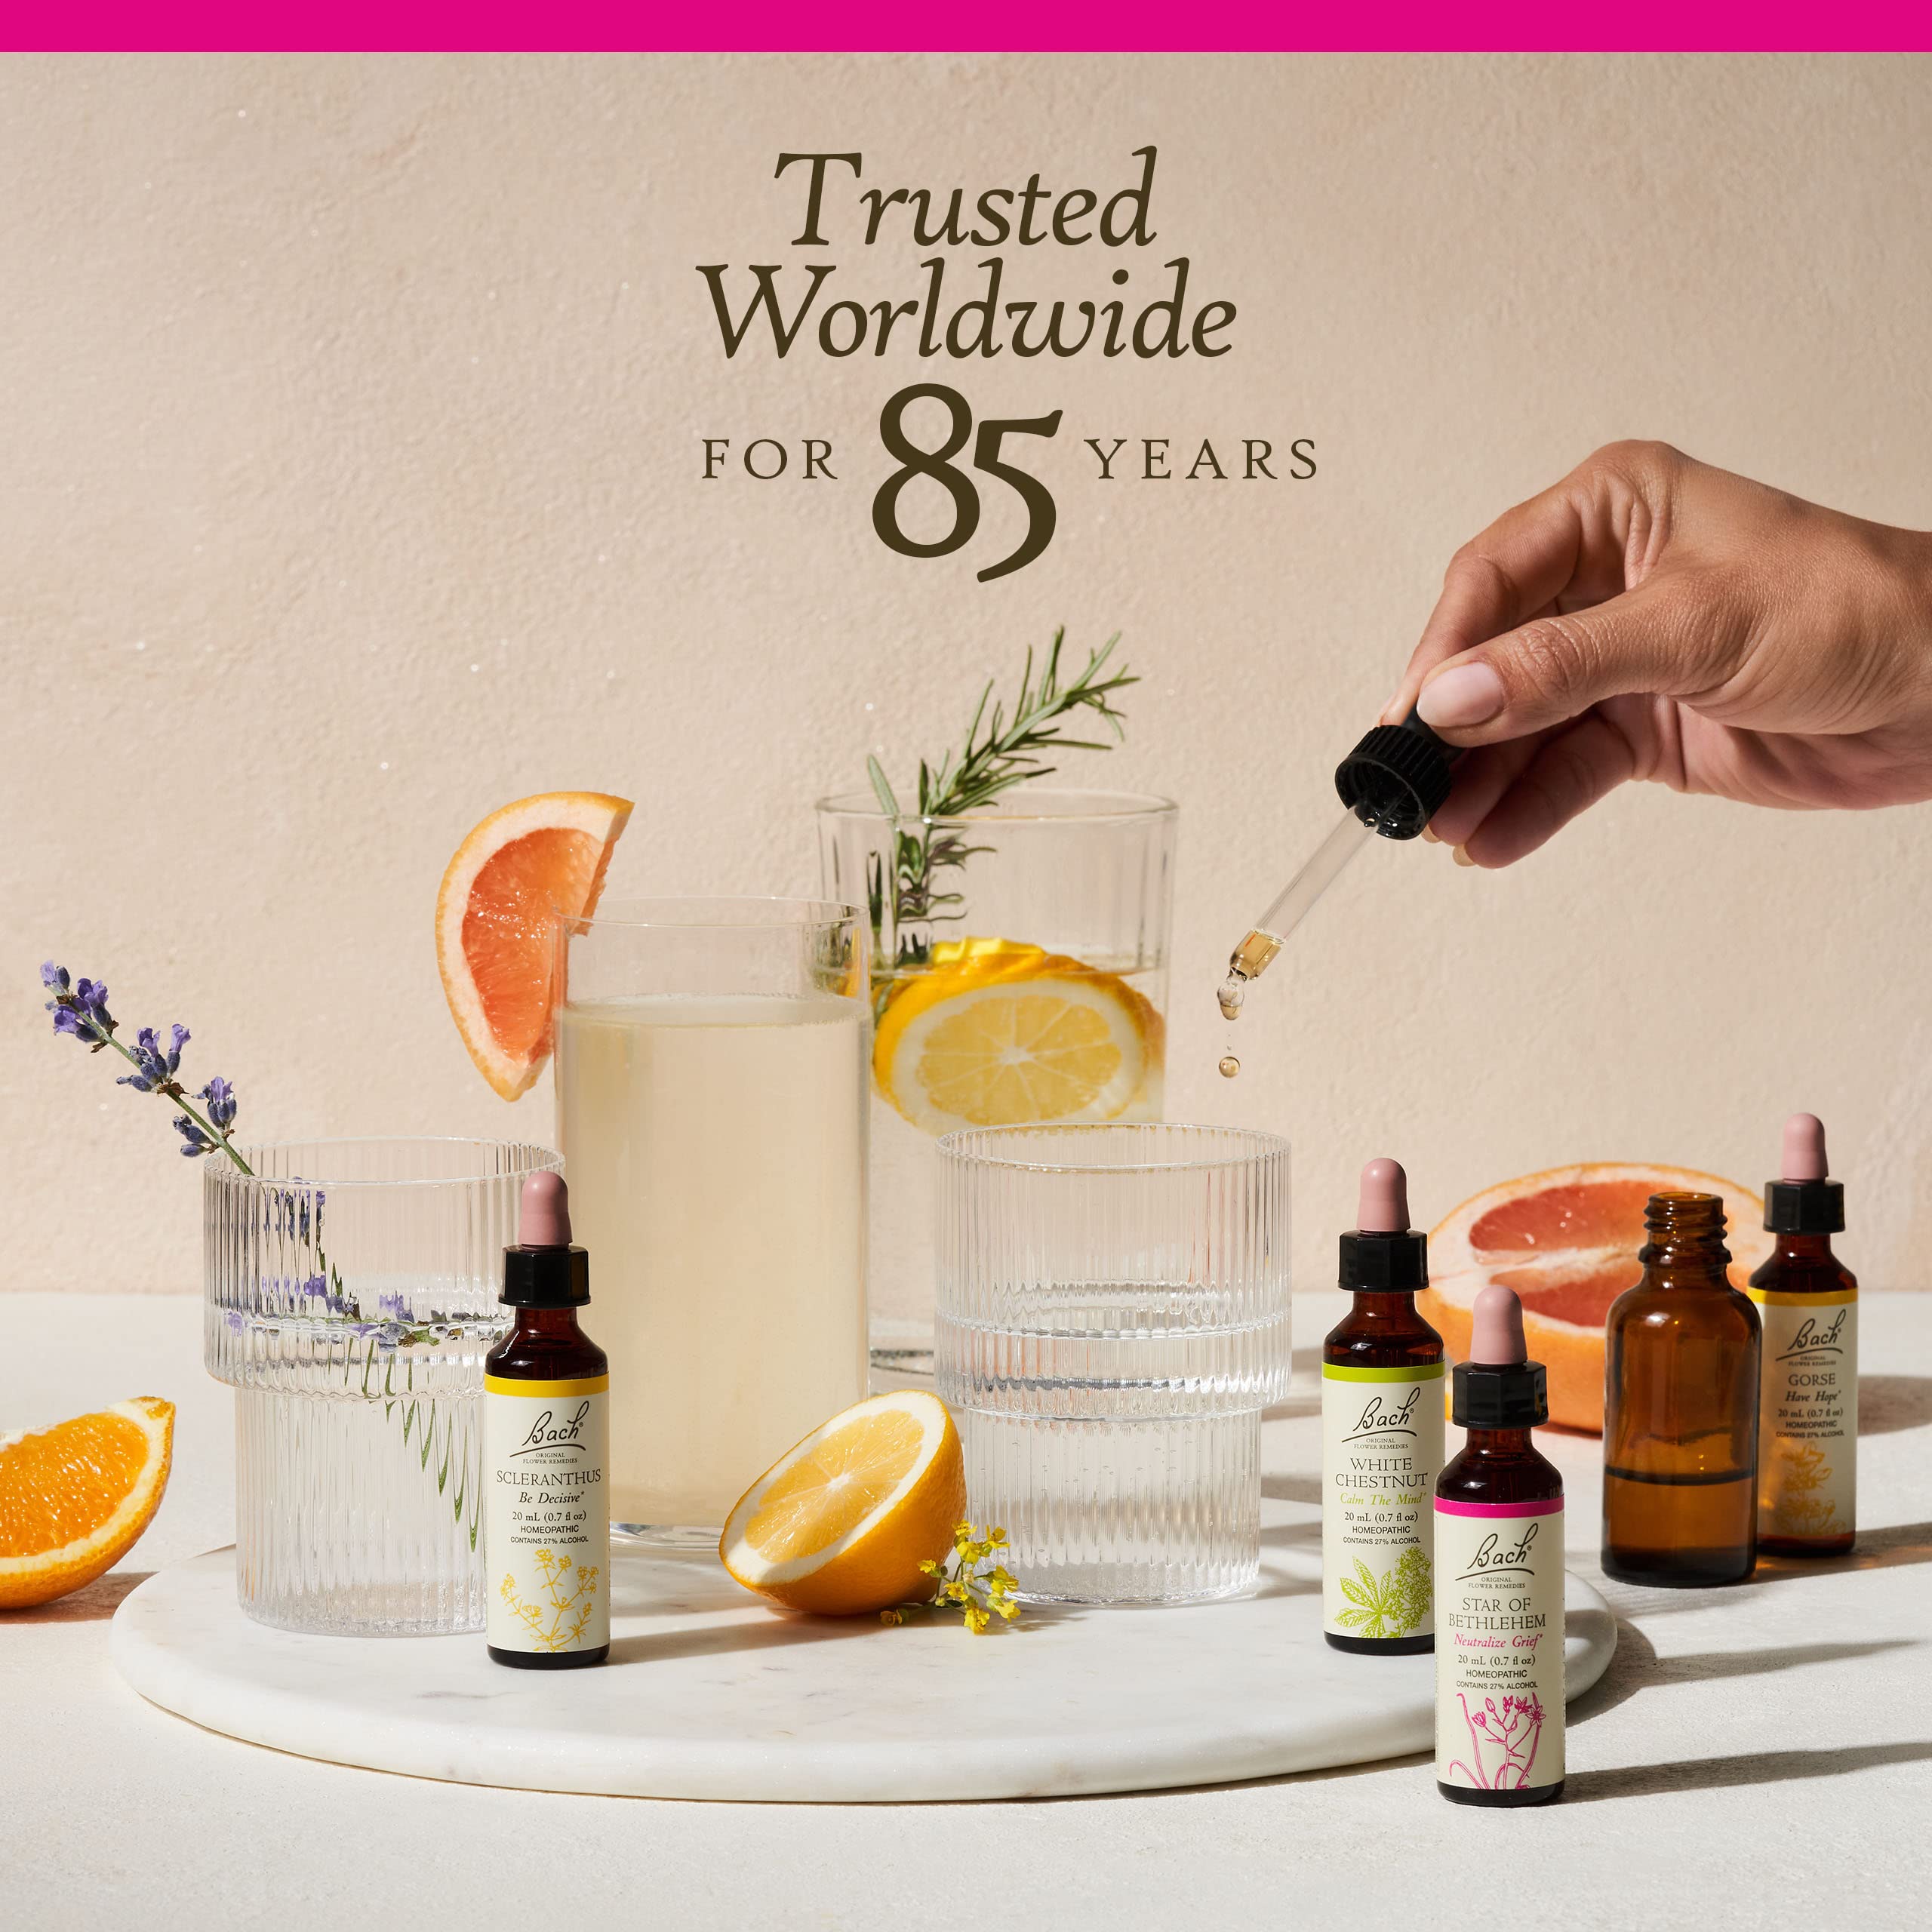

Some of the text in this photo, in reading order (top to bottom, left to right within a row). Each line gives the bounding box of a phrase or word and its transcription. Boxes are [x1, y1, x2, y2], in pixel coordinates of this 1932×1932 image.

[1789, 1373, 1835, 1386] GORSE
[1785, 1391, 1810, 1401] Have
[1778, 1409, 1787, 1417] 20
[1807, 1409, 1823, 1419] (0.7
[1350, 1458, 1412, 1471] WHITE
[497, 1469, 601, 1485] SCLERANTHUS
[1336, 1472, 1428, 1488] CHESTNUT
[519, 1491, 532, 1503] Be
[1340, 1493, 1364, 1505] Calm
[1371, 1494, 1392, 1505] The
[512, 1510, 586, 1523] 20 mL (0.7 fl oz)
[1345, 1511, 1418, 1524] 20 mL (0.7 fl oz)
[521, 1524, 580, 1534] HOMEOPATHIC
[560, 1536, 589, 1544] ALCOHOL
[1463, 1598, 1531, 1611] STAR OF
[1449, 1614, 1546, 1630] BETHLEHEM
[1454, 1633, 1506, 1647] Neutralize
[1458, 1654, 1536, 1667] 20 mL (0.7 fl oz)
[1466, 1669, 1527, 1678] HOMEOPATHIC
[1457, 1681, 1488, 1689] CONTAINS
